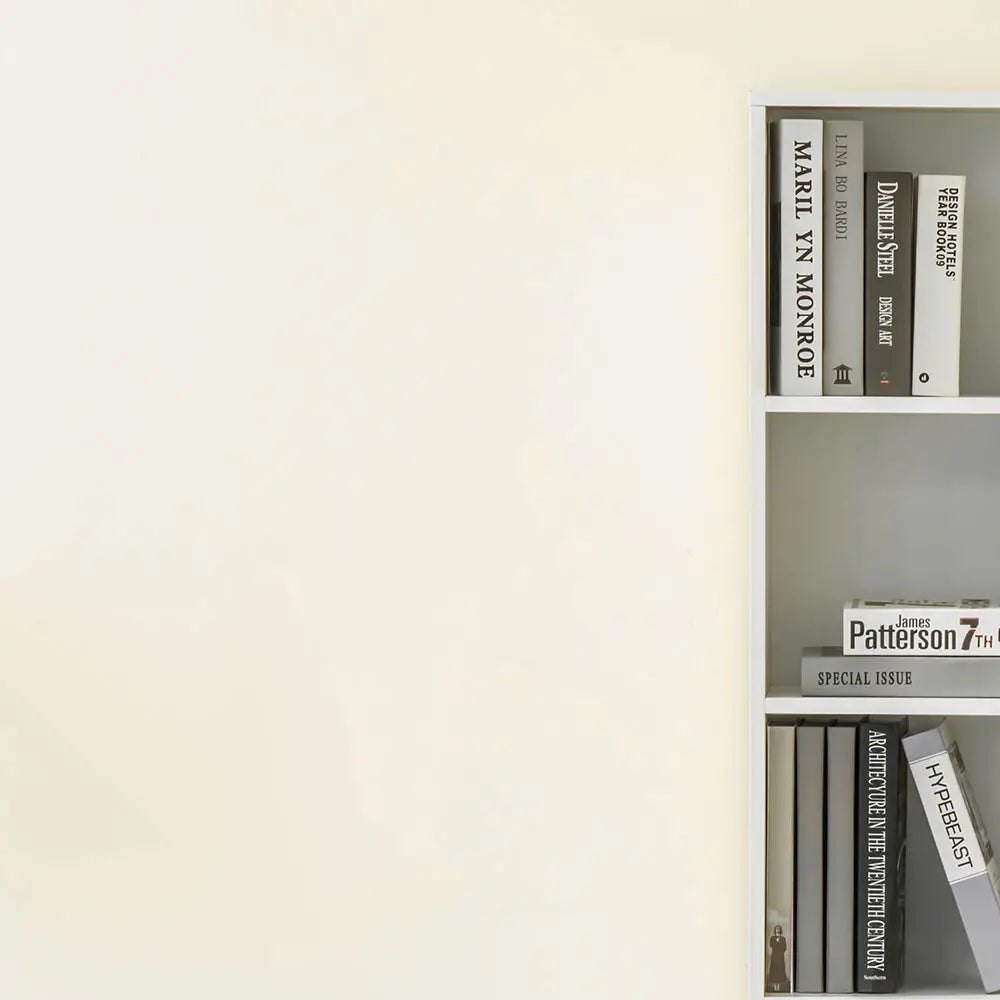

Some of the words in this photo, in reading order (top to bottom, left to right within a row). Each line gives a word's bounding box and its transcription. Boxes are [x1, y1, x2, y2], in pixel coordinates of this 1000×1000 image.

[836, 134, 848, 167] LINA
[794, 140, 813, 219] MARIL
[836, 176, 847, 193] BO
[877, 182, 898, 241] DANIELLE
[938, 187, 949, 216] YEAR
[947, 188, 958, 229] DESIGN
[836, 201, 848, 240] BARDI
[796, 229, 813, 263] YN
[877, 241, 898, 278] STEEL
[796, 274, 815, 378] MONROE
[879, 297, 892, 327] DESIGN
[879, 330, 892, 346] ART
[850, 621, 956, 650] Patterson
[896, 615, 930, 628] James
[818, 672, 871, 685] SPECIAL
[876, 671, 912, 685] ISSUE
[868, 730, 886, 815] ARCHITECYURE
[868, 817, 886, 829] IN
[926, 763, 973, 868] HYPEBEAST
[868, 831, 886, 853] THE
[867, 855, 886, 918] TWENTIETH
[867, 920, 885, 972] CENTURY
